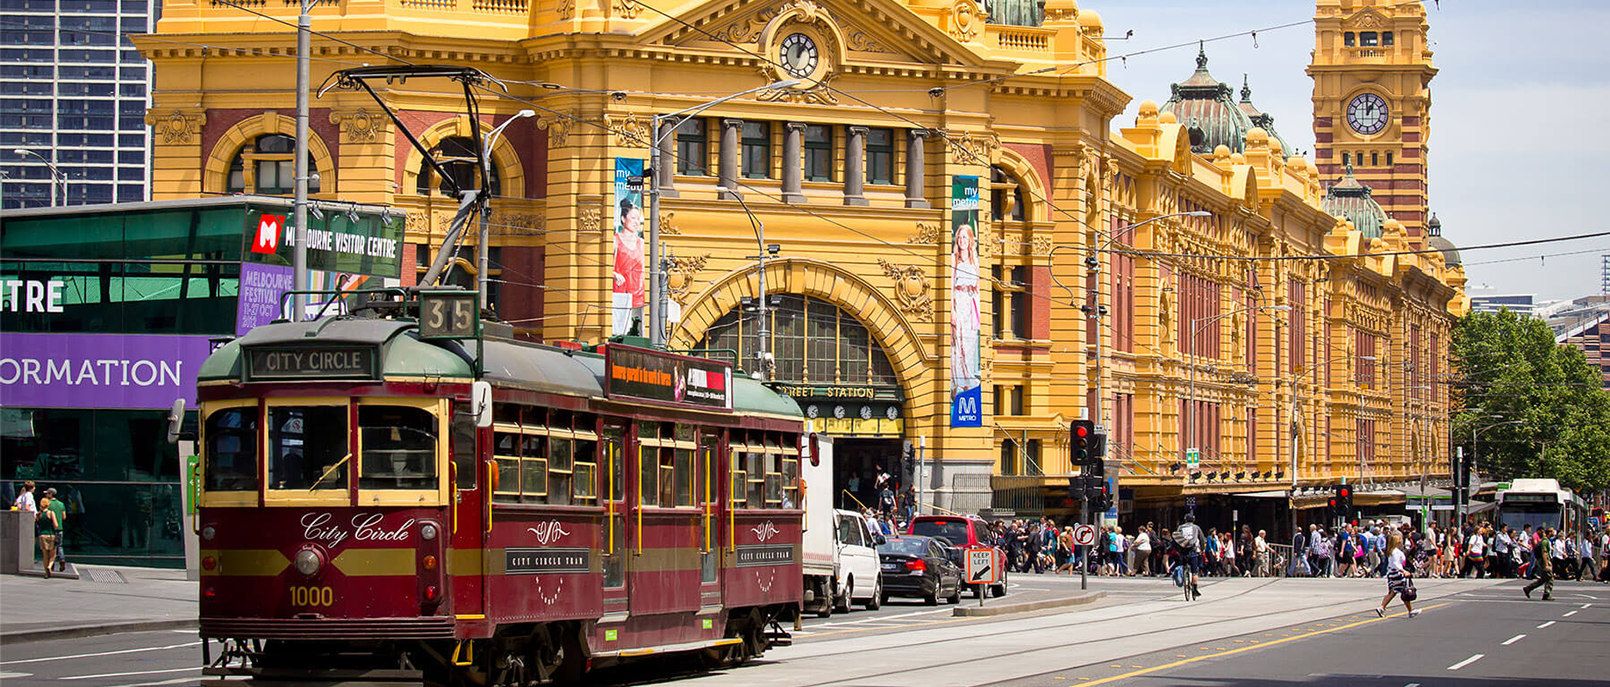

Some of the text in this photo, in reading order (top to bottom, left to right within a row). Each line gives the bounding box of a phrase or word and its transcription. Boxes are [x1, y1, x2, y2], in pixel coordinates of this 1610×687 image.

[616, 170, 630, 181] my
[964, 187, 978, 197] my
[953, 198, 978, 207] metro
[335, 232, 365, 255] VISITOR
[367, 237, 397, 258] CENTRE
[245, 270, 293, 290] MELBOURNE
[0, 280, 64, 313] TRE
[244, 287, 278, 304] FESTIVAL
[259, 304, 274, 317] OCT
[266, 351, 361, 371] CITY CIRCLE
[0, 358, 183, 386] ORMATION
[827, 386, 874, 398] STATION
[300, 512, 415, 548] City Circle
[512, 556, 583, 566] CITY CIRCLE TRAM
[740, 551, 789, 560] CITY CIRCLE TRAM
[289, 586, 333, 606] 1000
